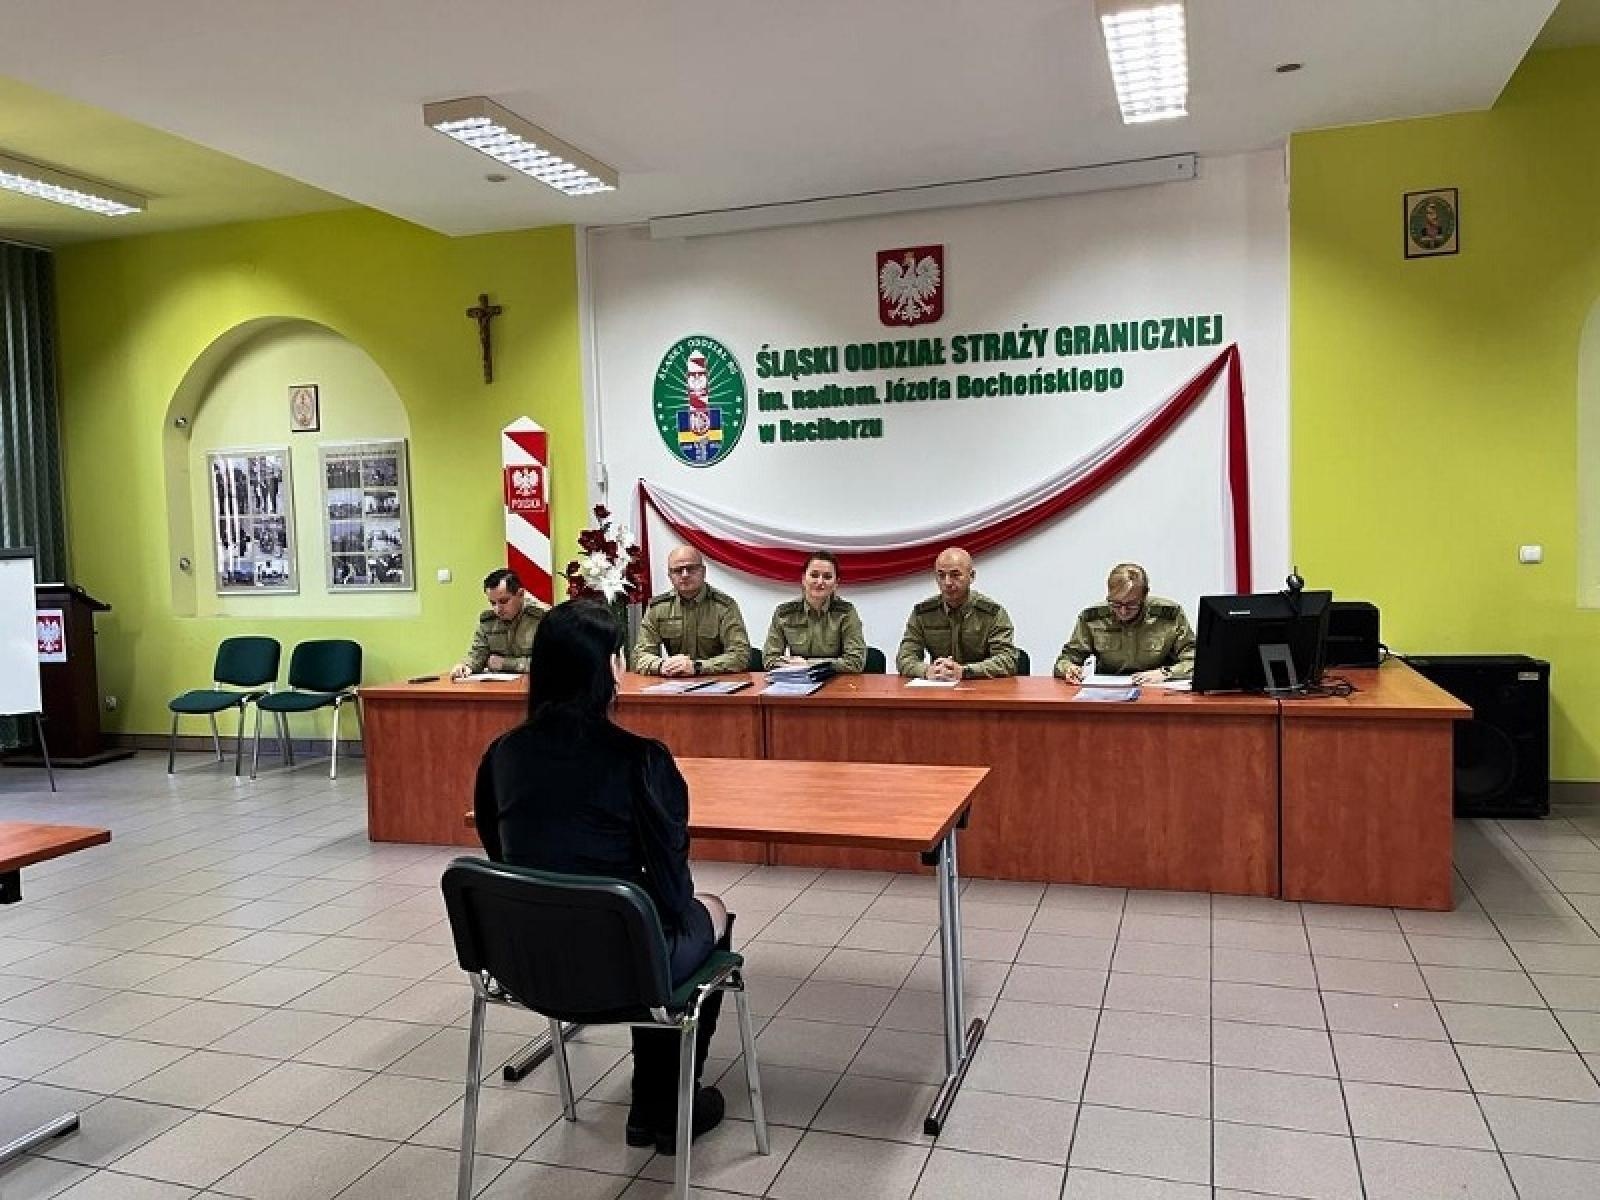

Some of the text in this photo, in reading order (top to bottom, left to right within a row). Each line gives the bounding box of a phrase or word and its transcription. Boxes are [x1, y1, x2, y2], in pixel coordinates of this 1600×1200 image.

[756, 343, 838, 380] ŚLĄSKI
[844, 337, 946, 372] ODDZIAŁ
[951, 323, 1048, 363] STRAŻY
[1055, 314, 1223, 356] GRANICZNEJ
[757, 367, 1123, 411] im. nadkom. Józefa Bocheńskiego
[758, 417, 883, 443] w Raciborzu
